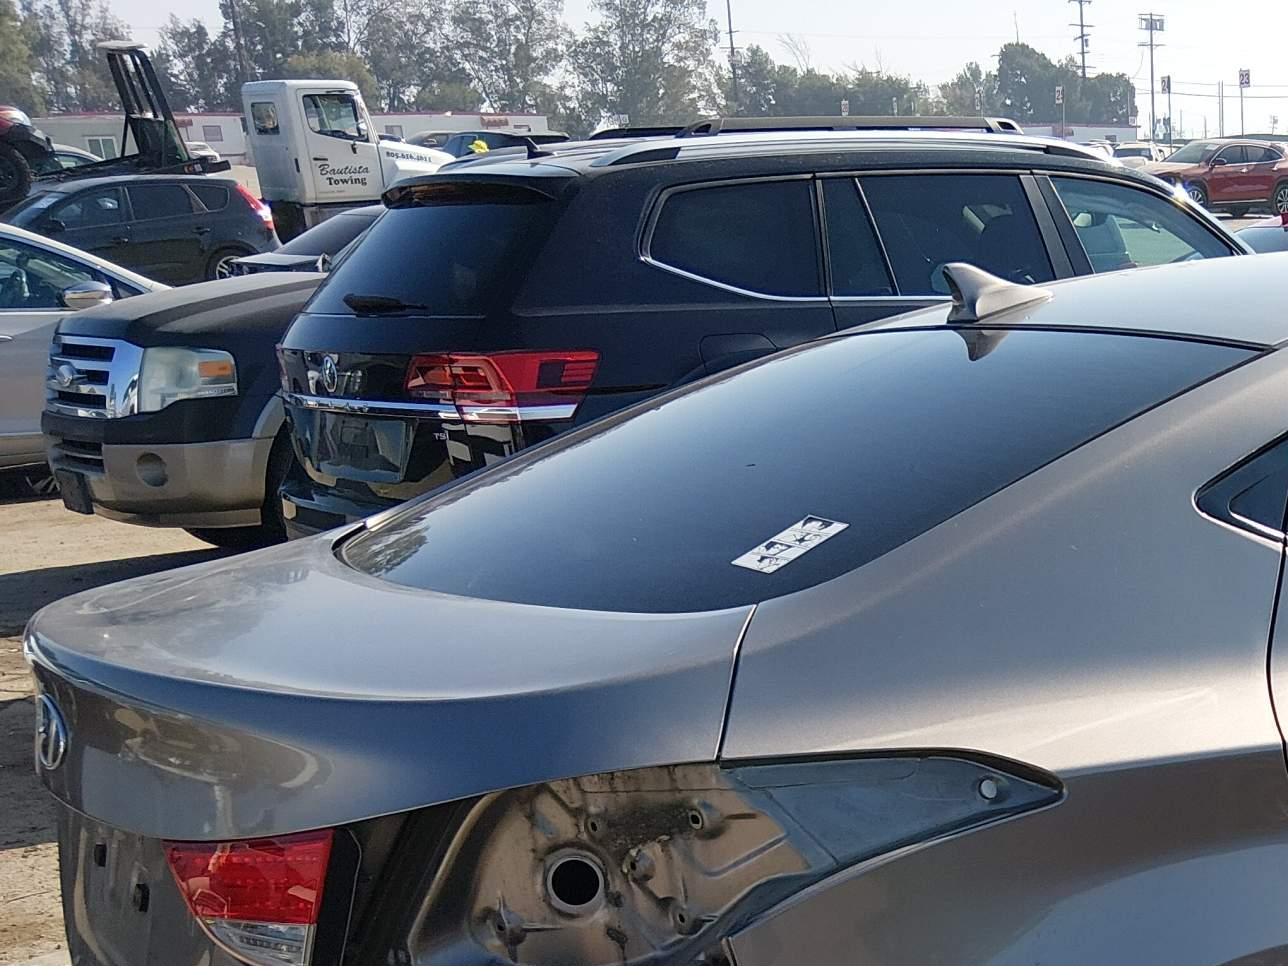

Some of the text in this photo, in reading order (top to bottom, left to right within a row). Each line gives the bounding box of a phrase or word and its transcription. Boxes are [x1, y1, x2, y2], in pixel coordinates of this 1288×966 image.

[1240, 73, 1250, 84] 23
[318, 163, 370, 176] Bautista
[326, 176, 367, 186] Towing
